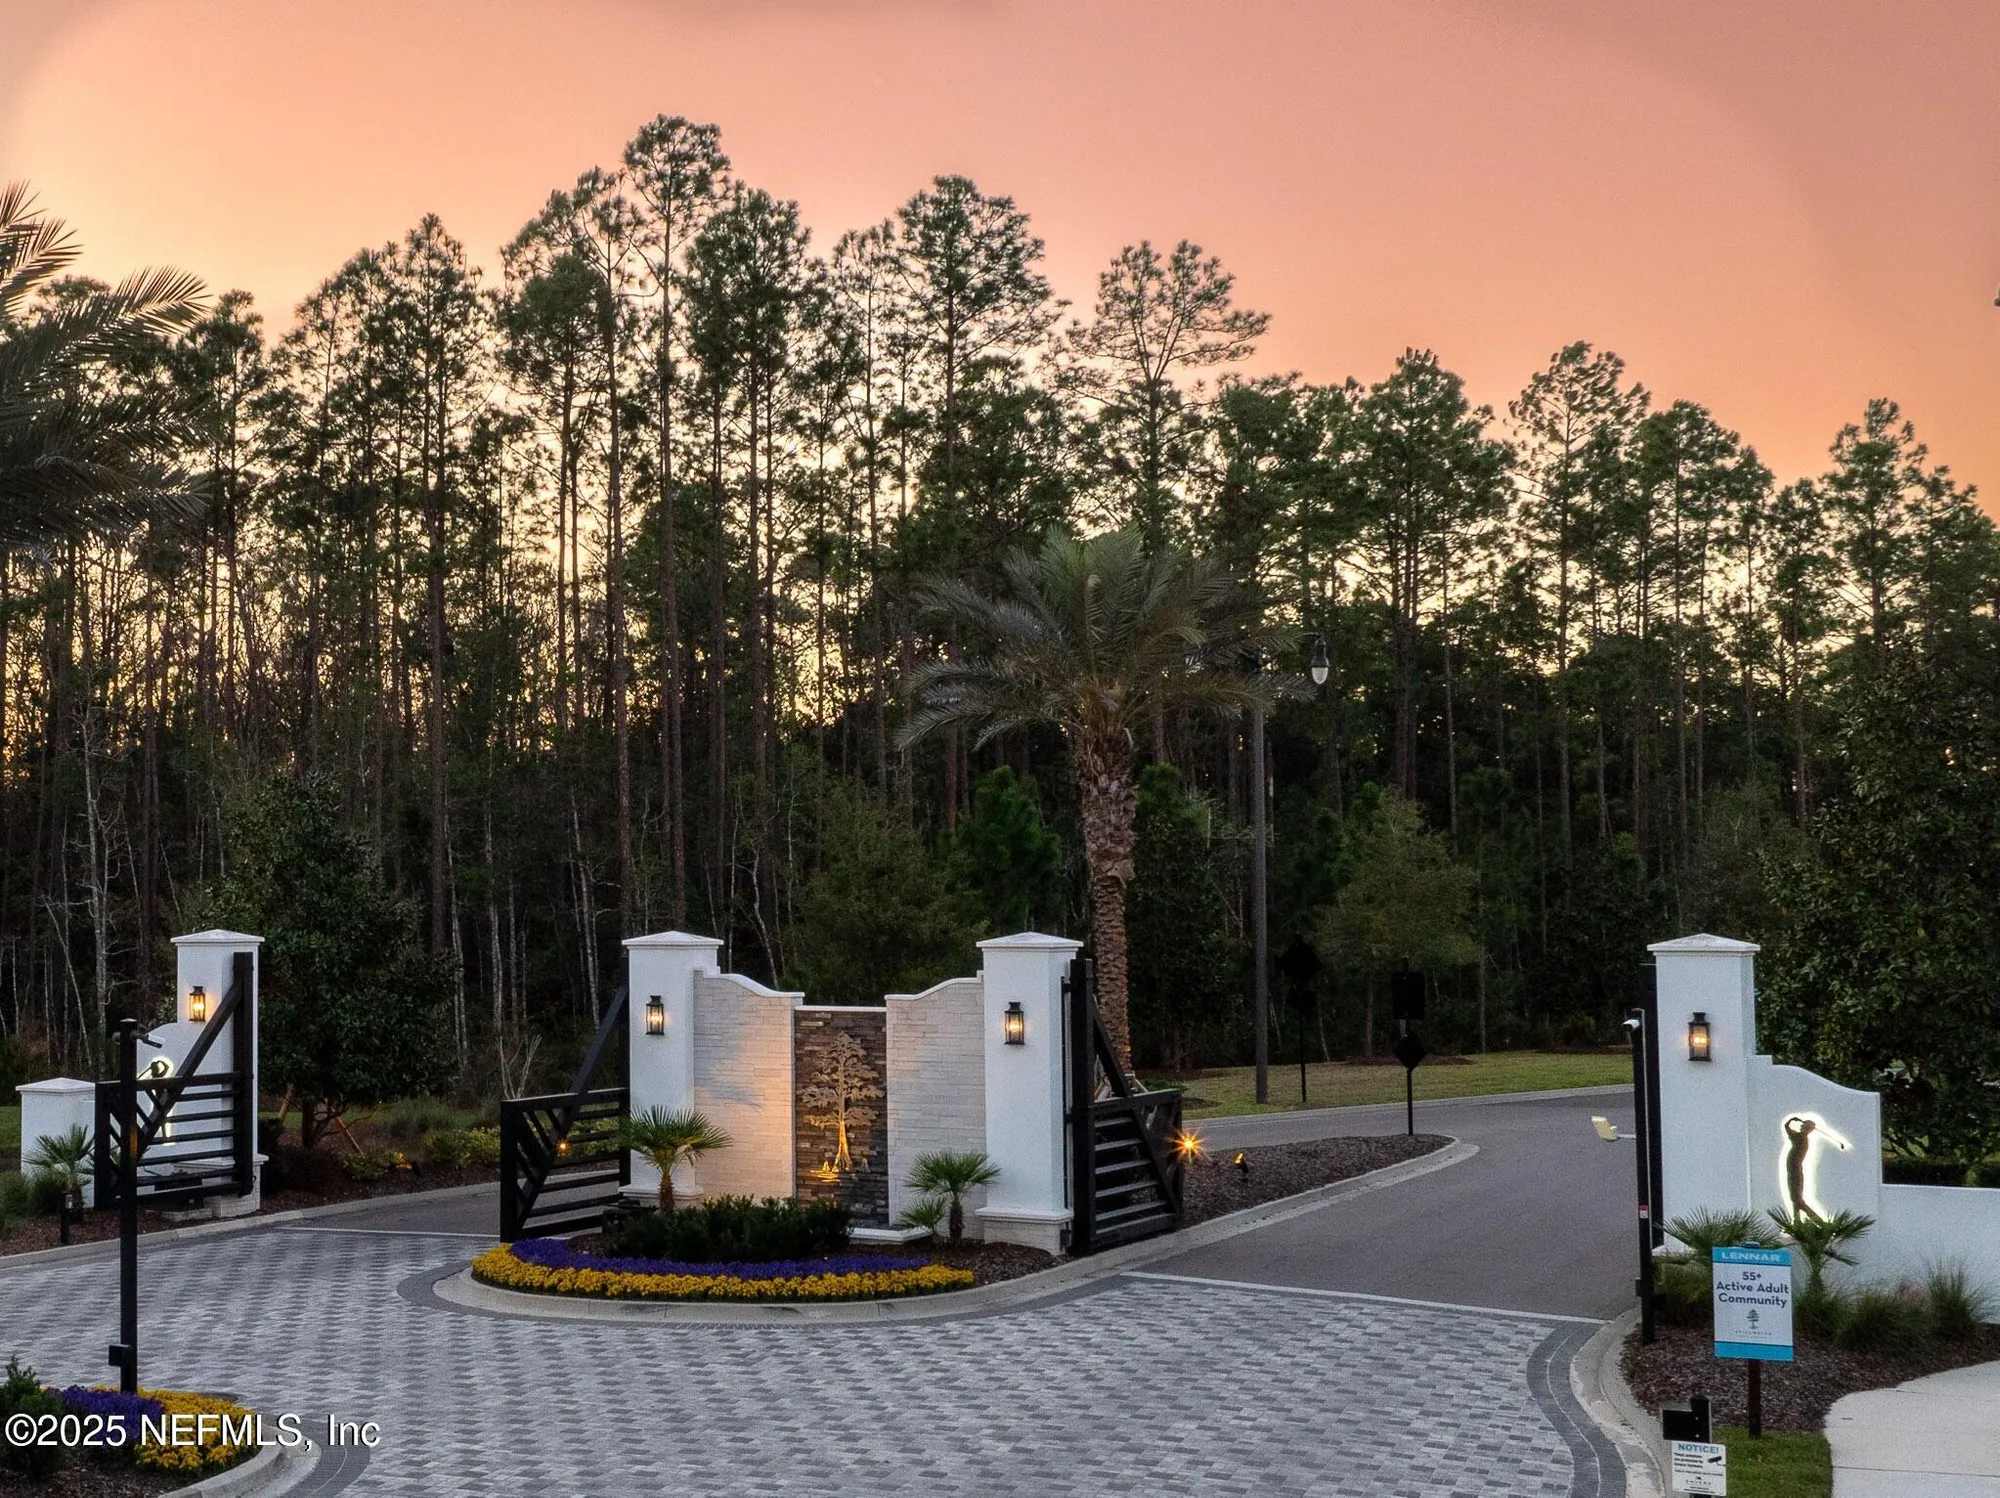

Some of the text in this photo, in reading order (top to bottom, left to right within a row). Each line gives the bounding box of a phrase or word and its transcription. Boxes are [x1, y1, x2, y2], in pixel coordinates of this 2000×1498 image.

[1721, 1251, 1781, 1262] LENNAR
[1742, 1271, 1762, 1281] 55+
[1716, 1281, 1789, 1294] Active Adult
[1718, 1292, 1788, 1308] Community
[1677, 1443, 1719, 1454] NOTICE!
